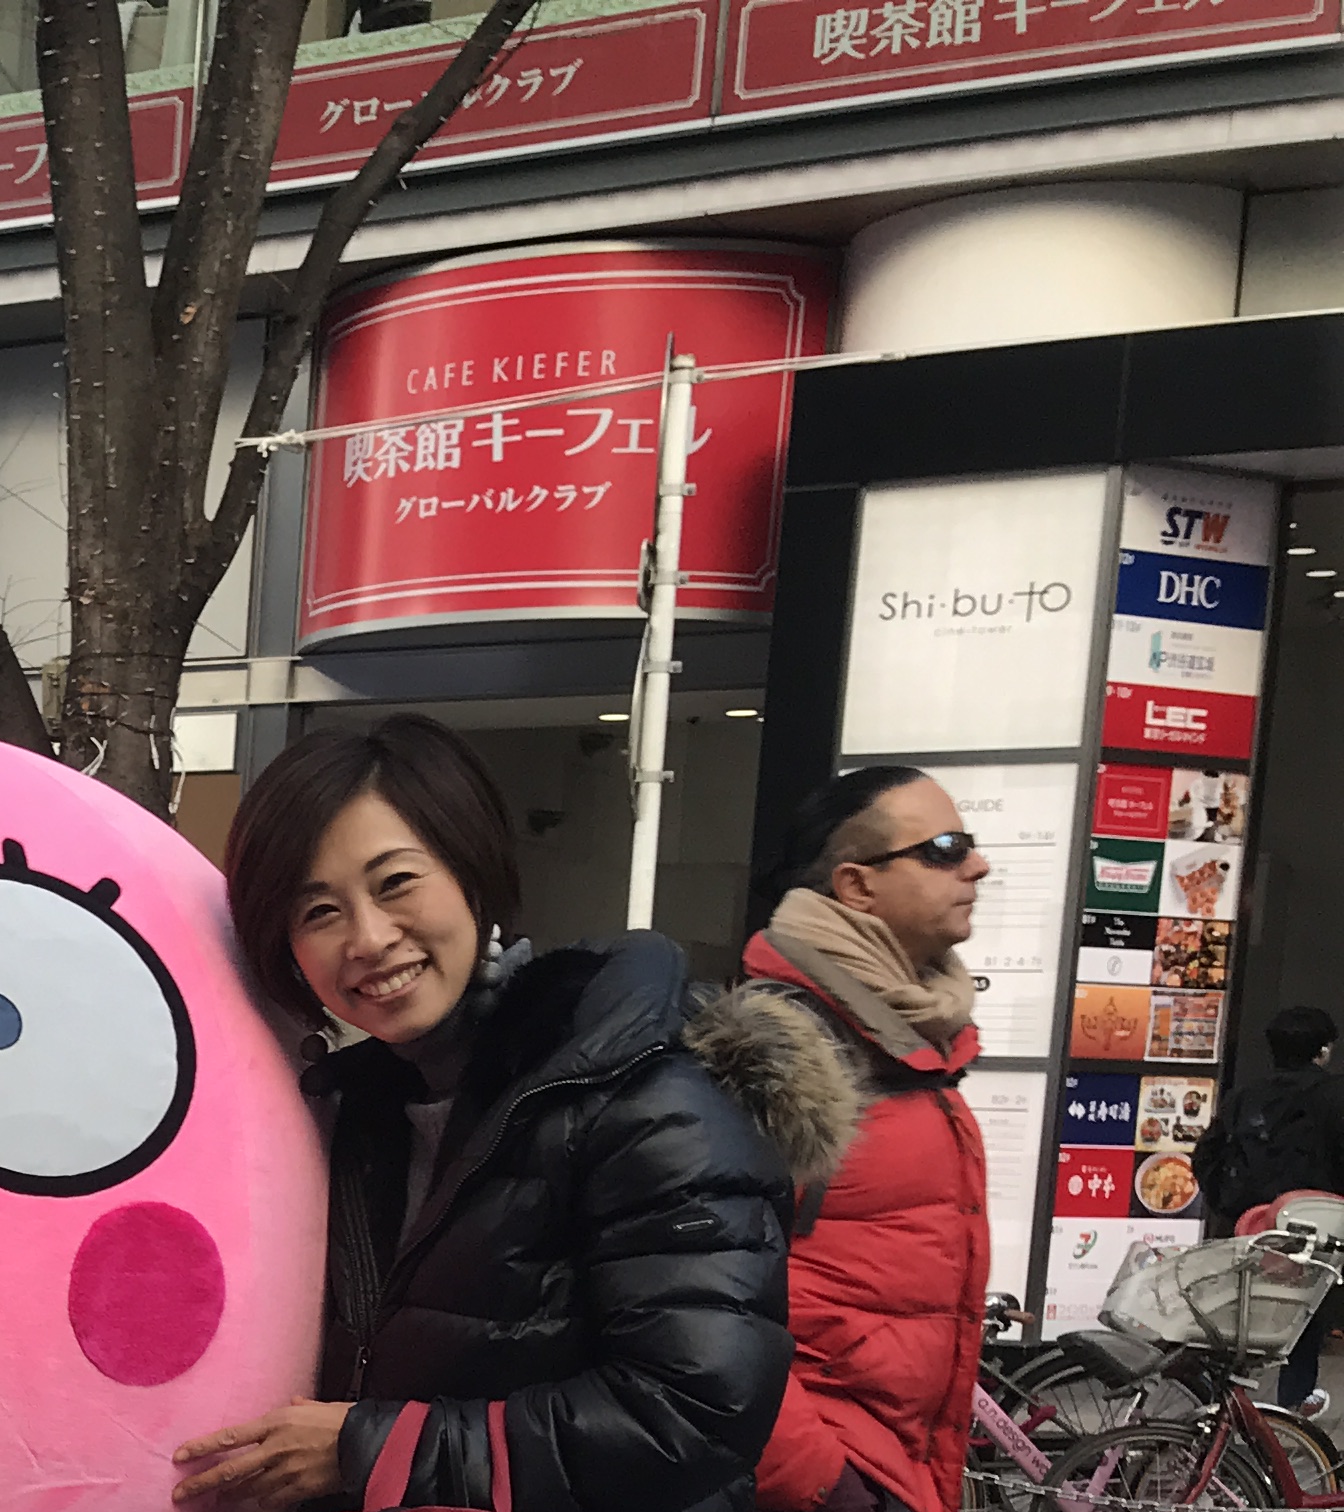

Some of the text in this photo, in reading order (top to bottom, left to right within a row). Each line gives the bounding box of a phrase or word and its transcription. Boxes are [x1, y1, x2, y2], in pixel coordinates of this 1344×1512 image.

[320, 58, 584, 134] グロークラブ
[406, 349, 617, 395] CAFE KIEFER
[395, 481, 614, 524] グローバルクラブ
[1161, 506, 1231, 544] STW
[1156, 570, 1222, 609] DHC
